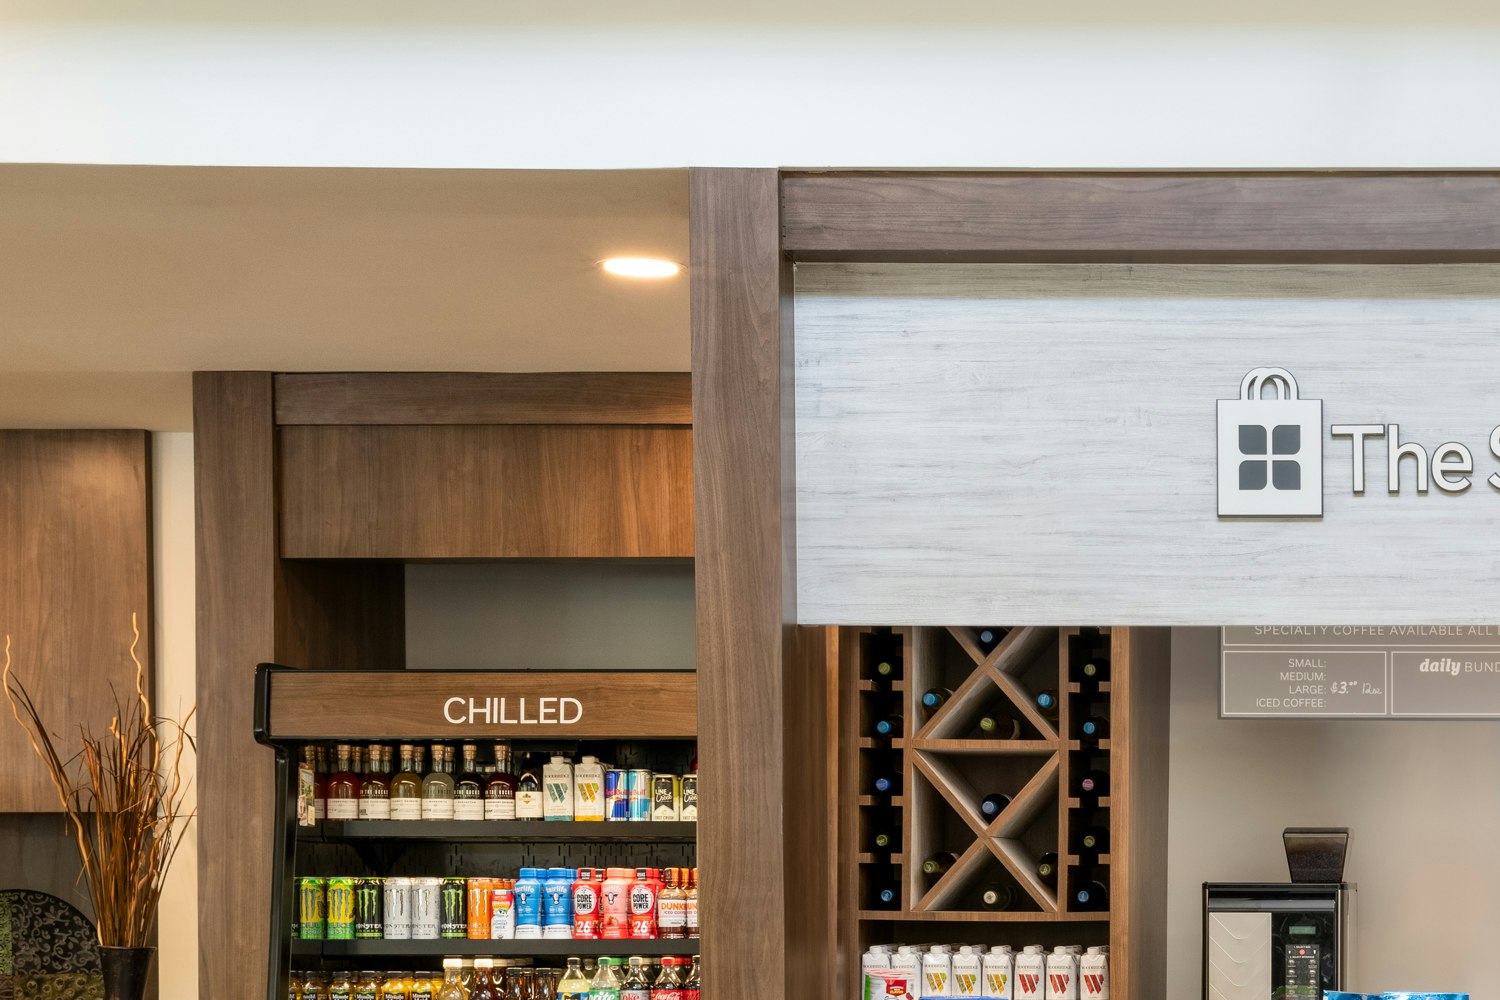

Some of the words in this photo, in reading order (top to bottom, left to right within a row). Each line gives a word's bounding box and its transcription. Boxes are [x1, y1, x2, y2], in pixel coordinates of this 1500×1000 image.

[1331, 423, 1473, 494] The
[1254, 626, 1327, 636] SPECIALTY
[1333, 626, 1384, 636] COFFEE
[1389, 626, 1463, 636] AVAILABLE
[1468, 626, 1492, 636] ALL
[1288, 659, 1326, 668] SMALL:
[1420, 659, 1460, 675] daily
[1280, 672, 1326, 681] MEDIUM:
[1289, 685, 1326, 694] LARGE:
[1256, 699, 1280, 708] ICED
[1283, 699, 1326, 708] COFFEE:
[443, 697, 583, 724] CHILLED
[577, 894, 591, 902] CORE
[633, 894, 648, 902] CORE
[655, 992, 680, 1000] Coca-Cola
